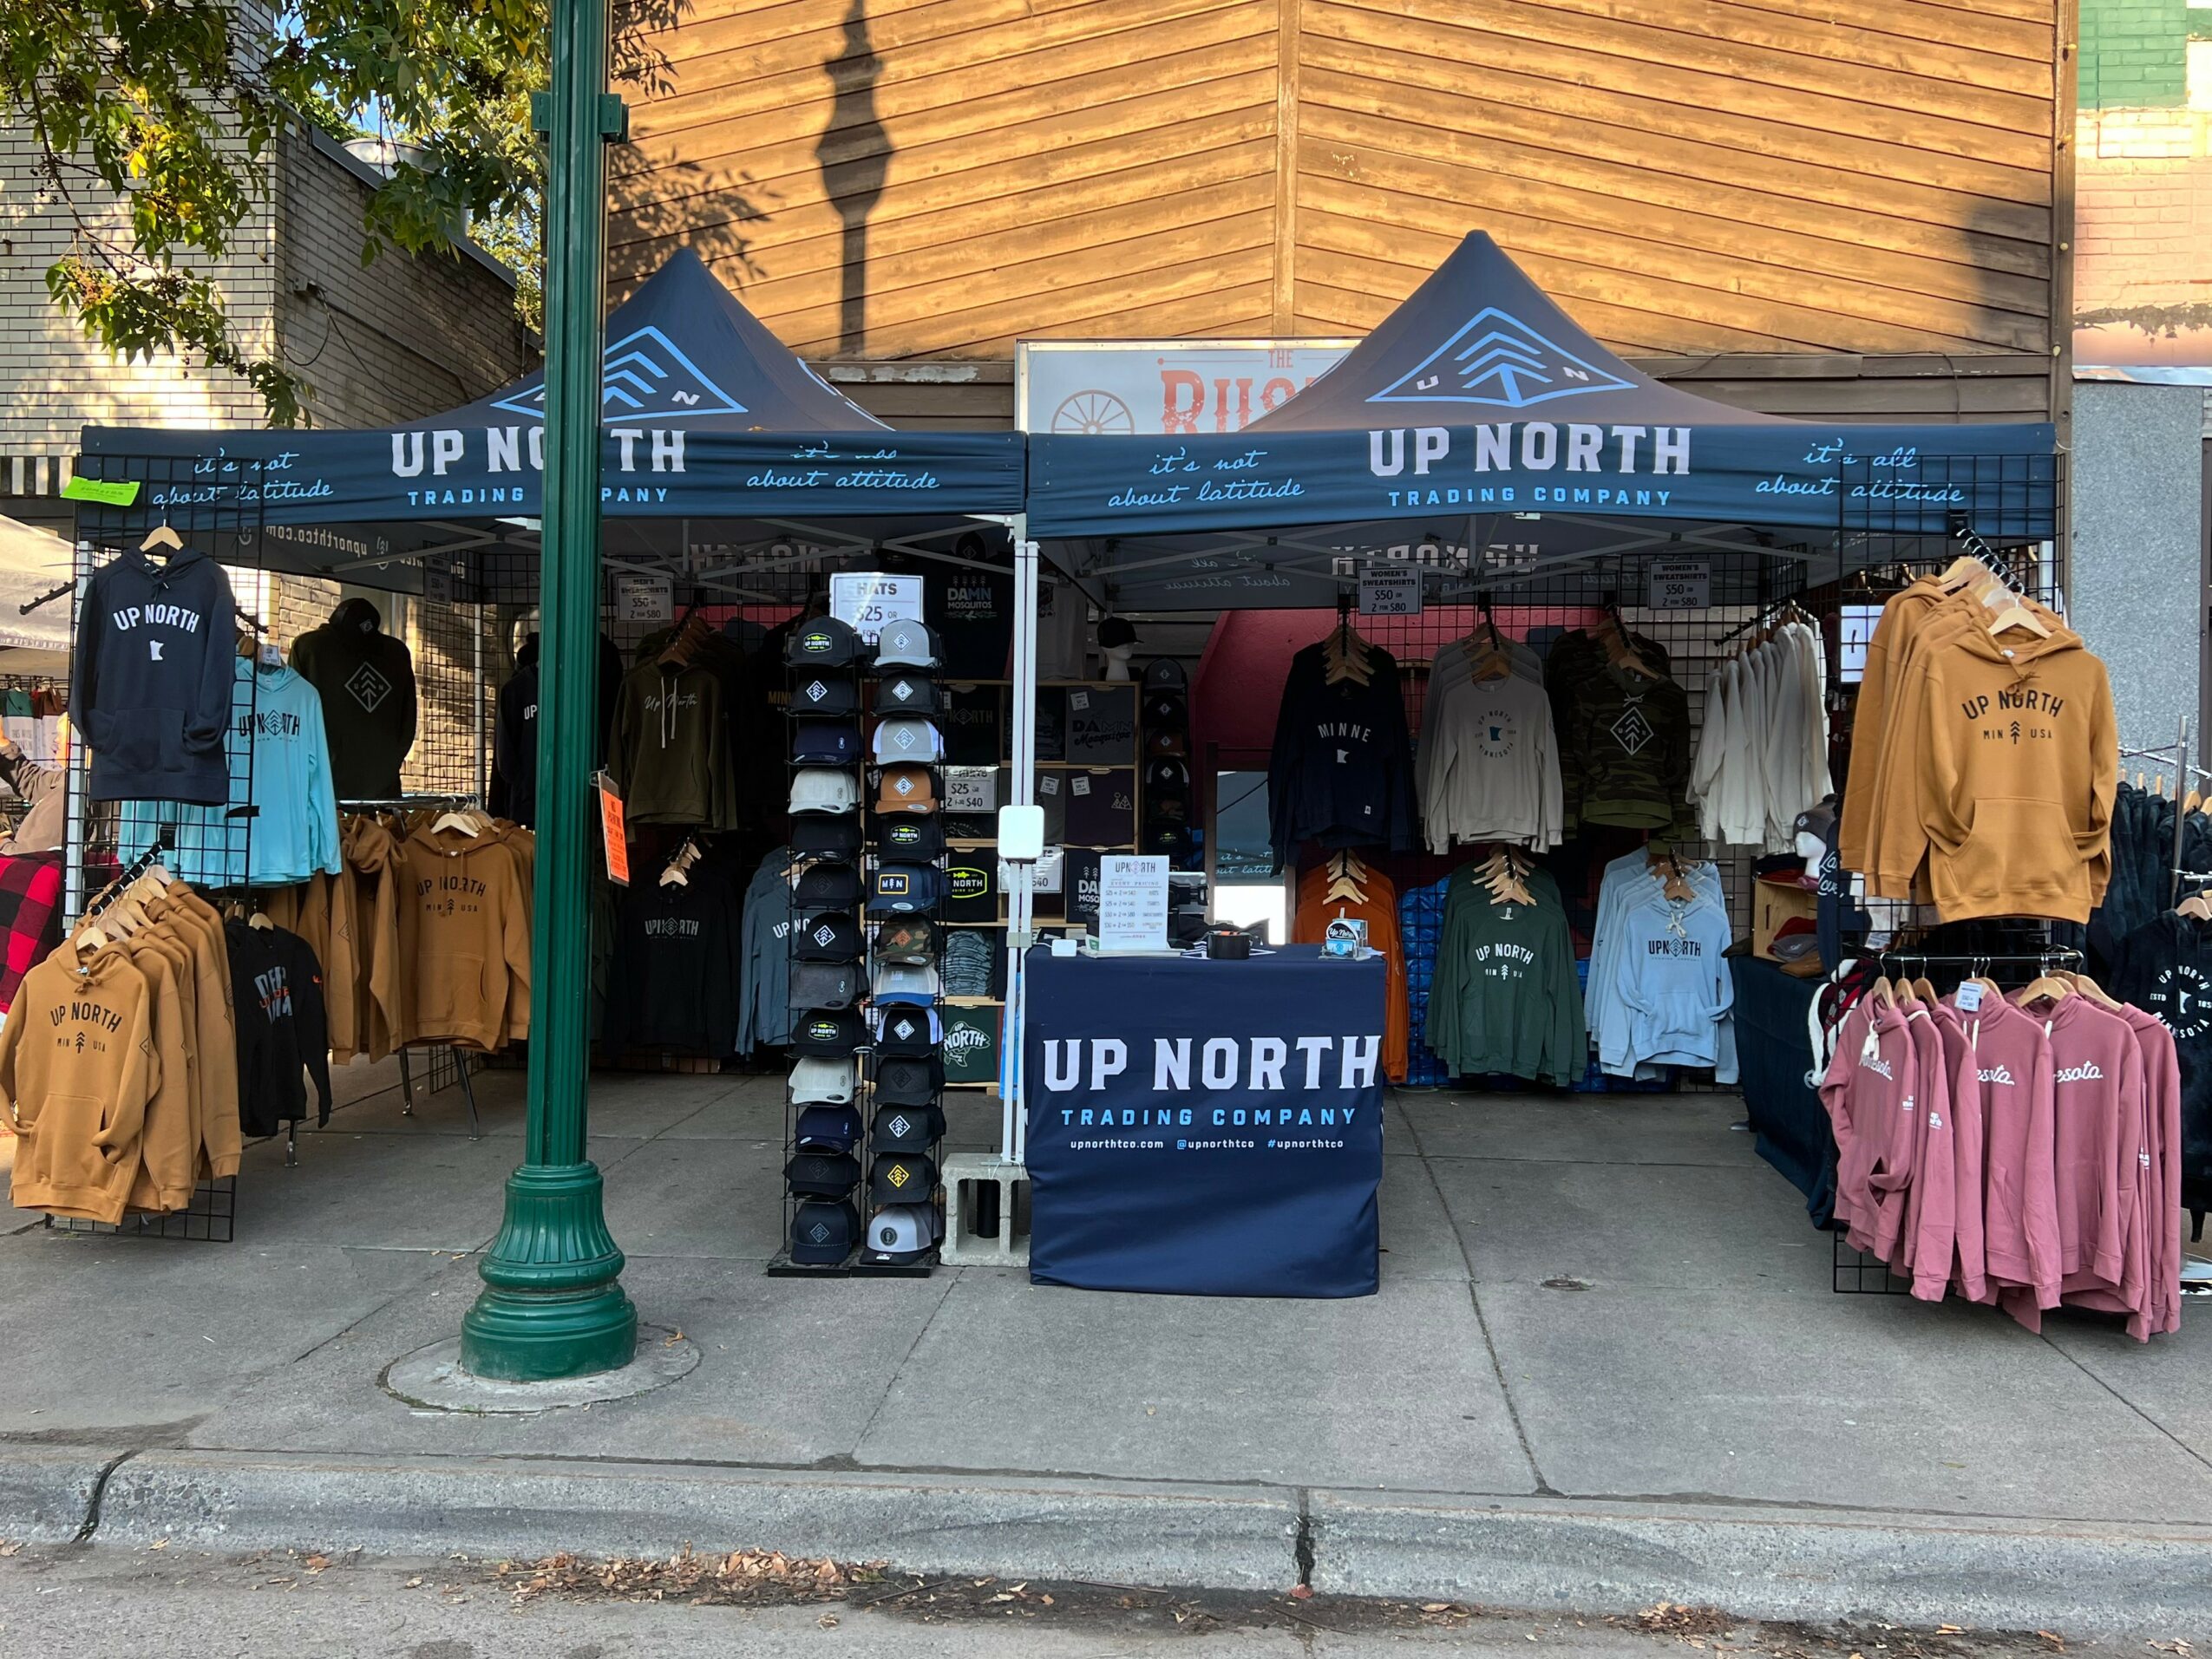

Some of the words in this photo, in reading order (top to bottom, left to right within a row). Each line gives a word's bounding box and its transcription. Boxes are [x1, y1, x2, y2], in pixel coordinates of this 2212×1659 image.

[1268, 349, 1293, 368] THE
[1161, 369, 1323, 433] RUS
[391, 429, 464, 477] UP
[1368, 428, 1450, 476] UP
[1475, 421, 1692, 474] NORTH
[1803, 437, 1857, 463] it's
[1872, 447, 1917, 467] all
[193, 447, 239, 474] it's
[251, 452, 299, 471] not
[1149, 447, 1201, 474] it's
[1214, 450, 1267, 469] not
[747, 469, 828, 487] about
[835, 470, 939, 488] attitude
[153, 487, 229, 506] about
[234, 479, 334, 500] latitude
[408, 487, 524, 506] TRADING
[600, 488, 668, 502] PANY
[1108, 486, 1189, 507] about
[1196, 478, 1305, 501] latitude
[1389, 487, 1515, 506] TRADING
[1534, 487, 1671, 506] COMPANY
[1755, 474, 1841, 495] about
[1851, 479, 1965, 502] attitude
[856, 583, 897, 595] HATS
[947, 588, 991, 601] DAMN
[1375, 590, 1393, 601] $50
[1666, 584, 1685, 595] $50
[632, 598, 649, 607] $50
[947, 601, 992, 611] MOSQUITOS
[1371, 604, 1377, 612] 2
[1390, 603, 1406, 612] $80
[1662, 598, 1667, 606] 2
[1681, 597, 1698, 606] $80
[114, 607, 140, 630] UP
[146, 604, 200, 633] NORTH
[856, 606, 883, 622] $25
[645, 695, 661, 710] Up
[1961, 696, 1989, 720] UP
[1998, 689, 2064, 717] NORTH
[524, 704, 537, 720] UP
[1072, 720, 1134, 732] DAMN
[1318, 722, 1371, 742] MINNE
[1983, 729, 2004, 739] MIN
[2030, 728, 2052, 738] USA
[952, 783, 969, 794] $25
[947, 798, 952, 807] 2
[966, 797, 983, 807] $40
[416, 879, 432, 896] UP
[439, 876, 486, 897] NORTH
[772, 923, 789, 938] UP
[1476, 949, 1489, 962] UP
[1495, 944, 1534, 964] NORTH
[2158, 970, 2172, 983] UP
[2150, 993, 2166, 1002] ESTD
[50, 1005, 66, 1027] UP
[71, 1002, 122, 1033] NORTH
[954, 1022, 964, 1031] UP
[57, 1038, 69, 1048] MIN
[93, 1041, 106, 1052] USA
[944, 1029, 985, 1052] NORTH
[1044, 1039, 1128, 1092] UP
[1153, 1035, 1381, 1090] NORTH
[1062, 1108, 1193, 1126] TRADING
[1213, 1108, 1355, 1126] COMPANY
[1070, 1140, 1164, 1150] upnorthtco.com
[1177, 1140, 1254, 1151] @upnorthtco
[1267, 1139, 1344, 1150] #upnorthtco
